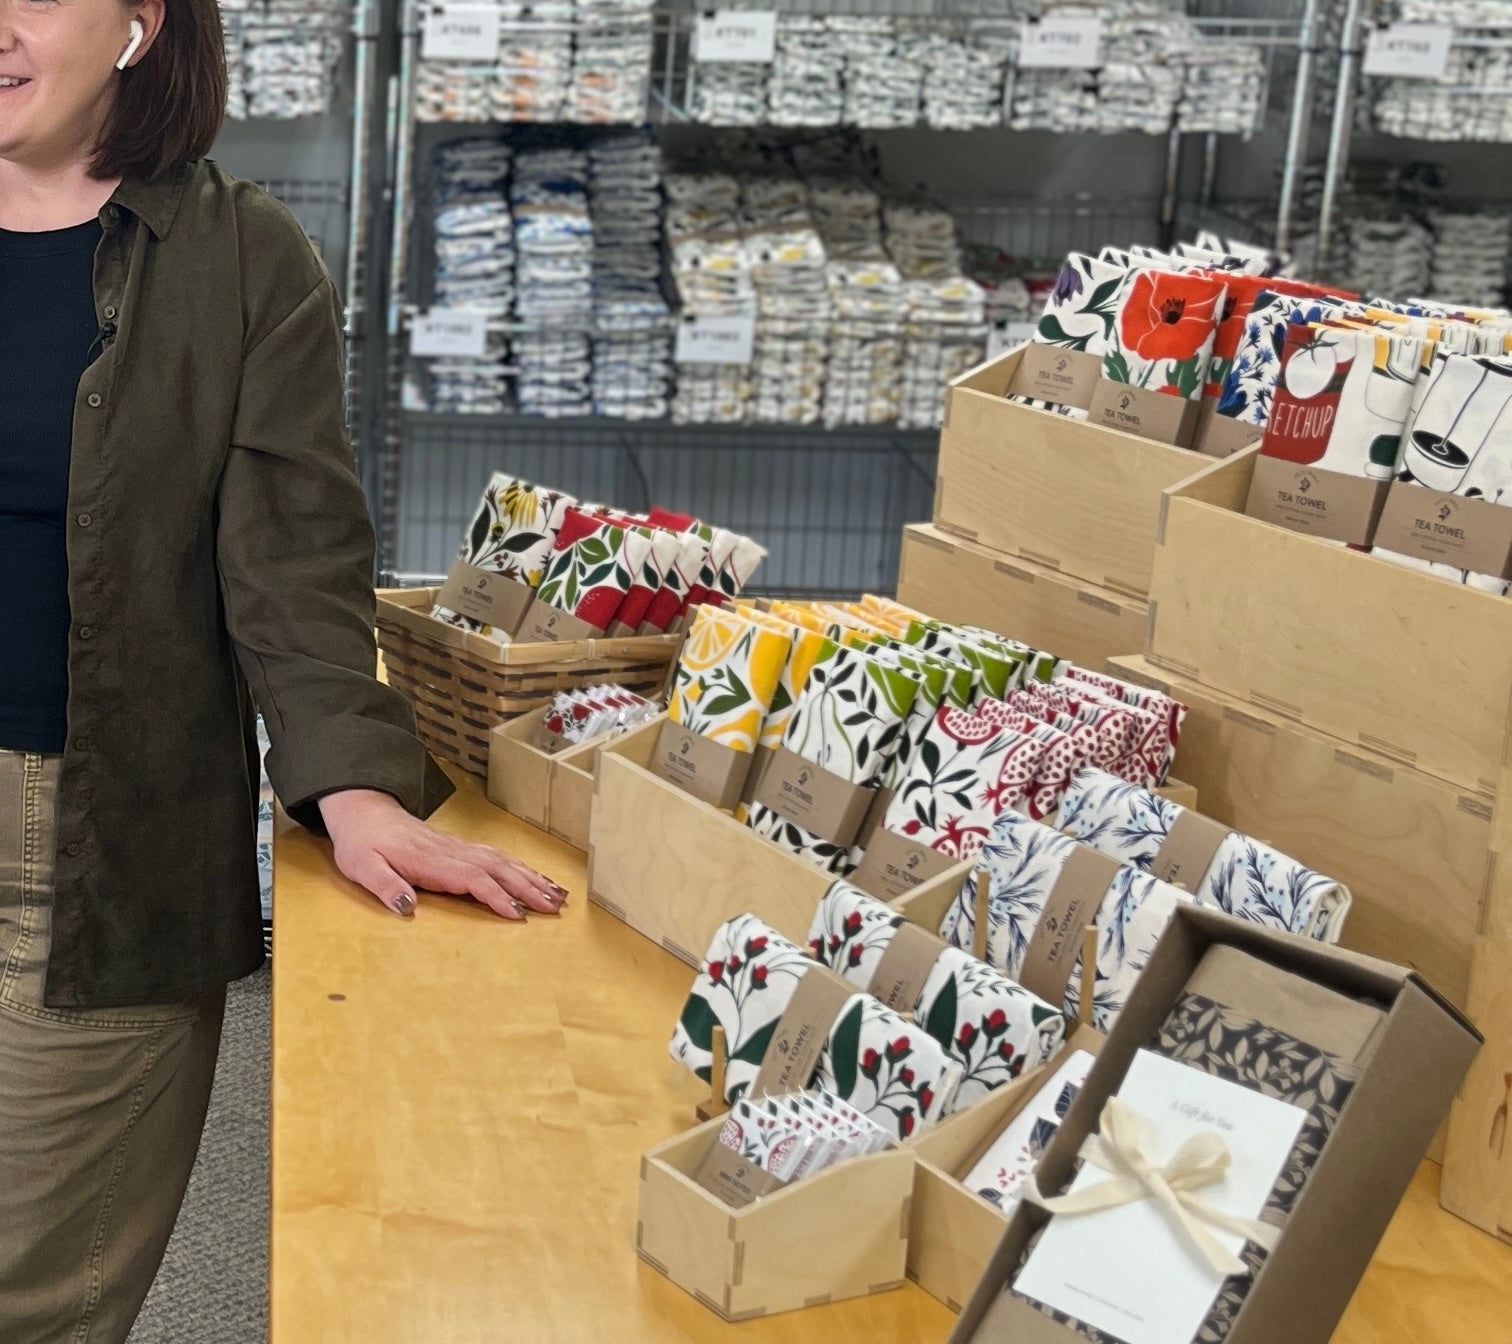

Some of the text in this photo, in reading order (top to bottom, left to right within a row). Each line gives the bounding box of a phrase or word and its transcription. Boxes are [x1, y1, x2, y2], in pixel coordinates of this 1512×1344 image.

[1037, 370, 1074, 385] TEA TOWEL
[1104, 408, 1141, 426] TEA TOWEL
[1278, 490, 1293, 503] TEA
[1295, 494, 1327, 511] TOWEL
[1414, 518, 1431, 531] TEA
[1433, 523, 1465, 540] TOWEL
[668, 751, 678, 763] TEA
[781, 780, 794, 793] TEA
[885, 863, 900, 877] TEA
[901, 870, 926, 886] TOWE
[1047, 942, 1060, 962] TEA
[1058, 898, 1081, 938] TOWEL
[779, 1066, 792, 1086] TEA
[791, 1024, 810, 1061] TOWEL
